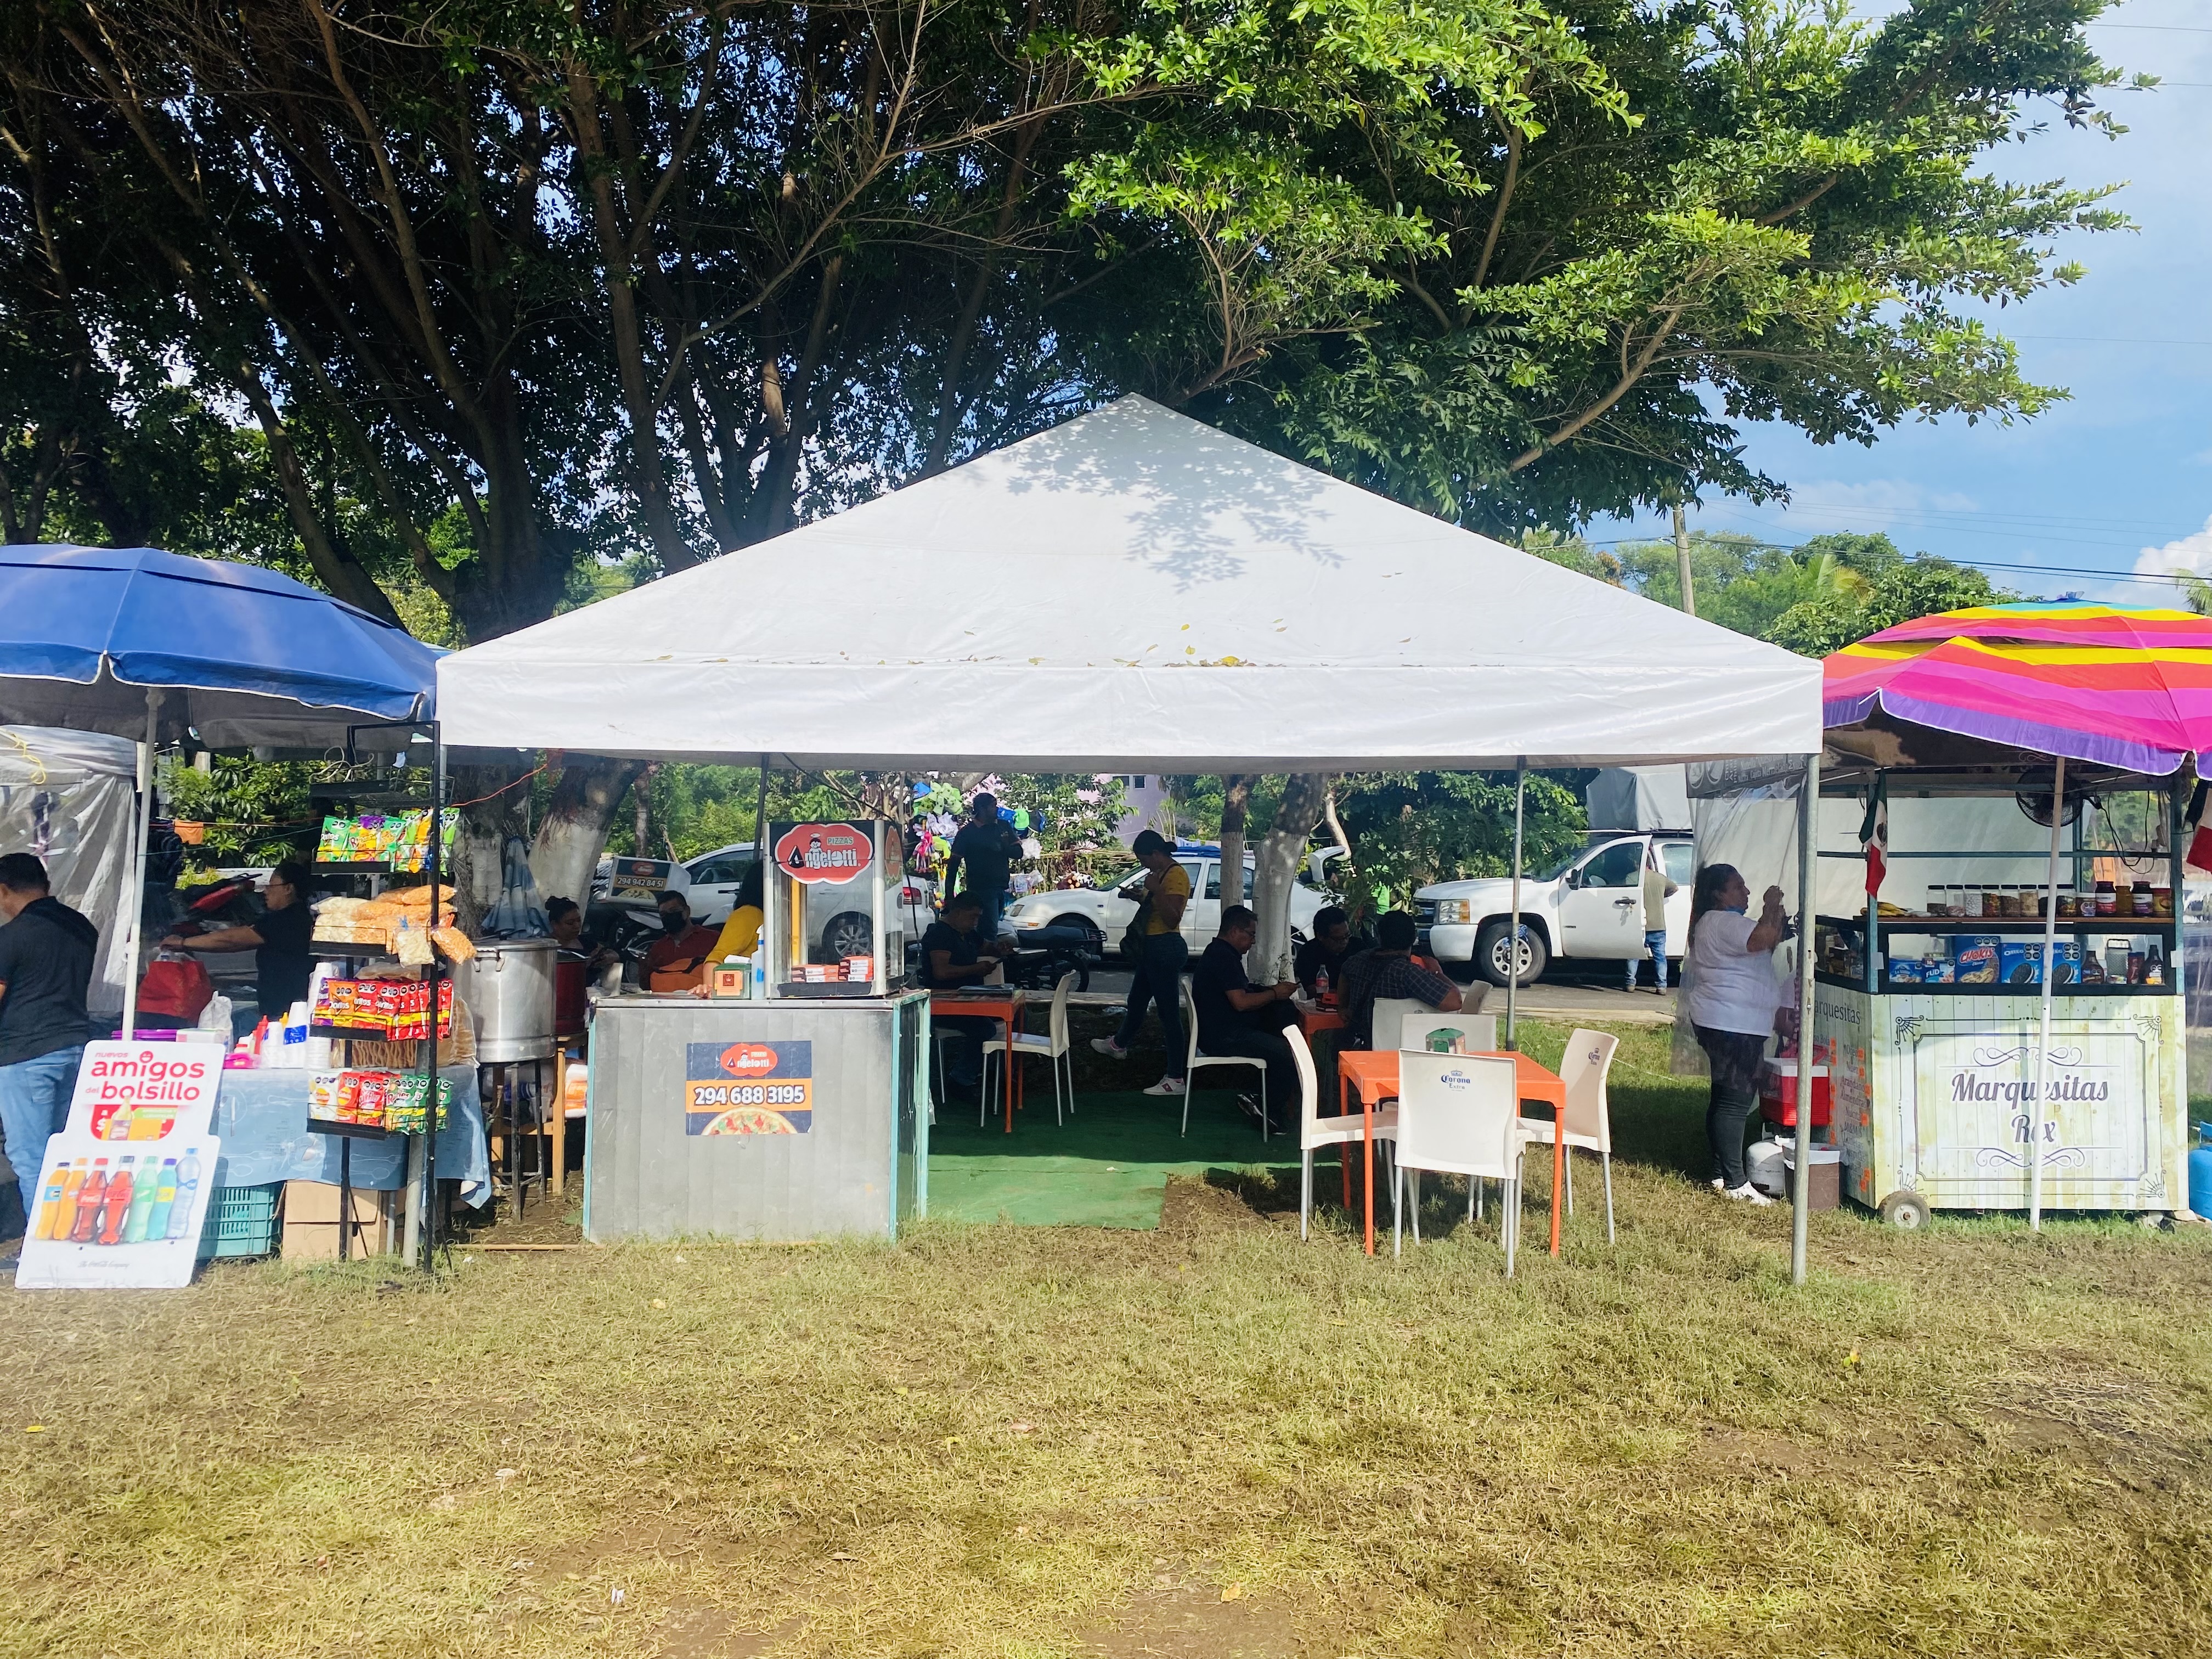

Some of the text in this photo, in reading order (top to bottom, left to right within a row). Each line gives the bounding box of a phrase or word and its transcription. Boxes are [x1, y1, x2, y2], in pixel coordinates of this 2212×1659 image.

[788, 845, 857, 870] Angelotti
[1961, 947, 1993, 964] CHOKIS
[1815, 1000, 1860, 1025] arquesitas
[91, 1051, 205, 1082] amigos
[1441, 1074, 1471, 1084] Corona
[100, 1081, 200, 1101] bolsillo
[694, 1085, 805, 1105] 294 688 3195
[1952, 1073, 2108, 1109] Marqusitas
[2012, 1114, 2055, 1142] Rx
